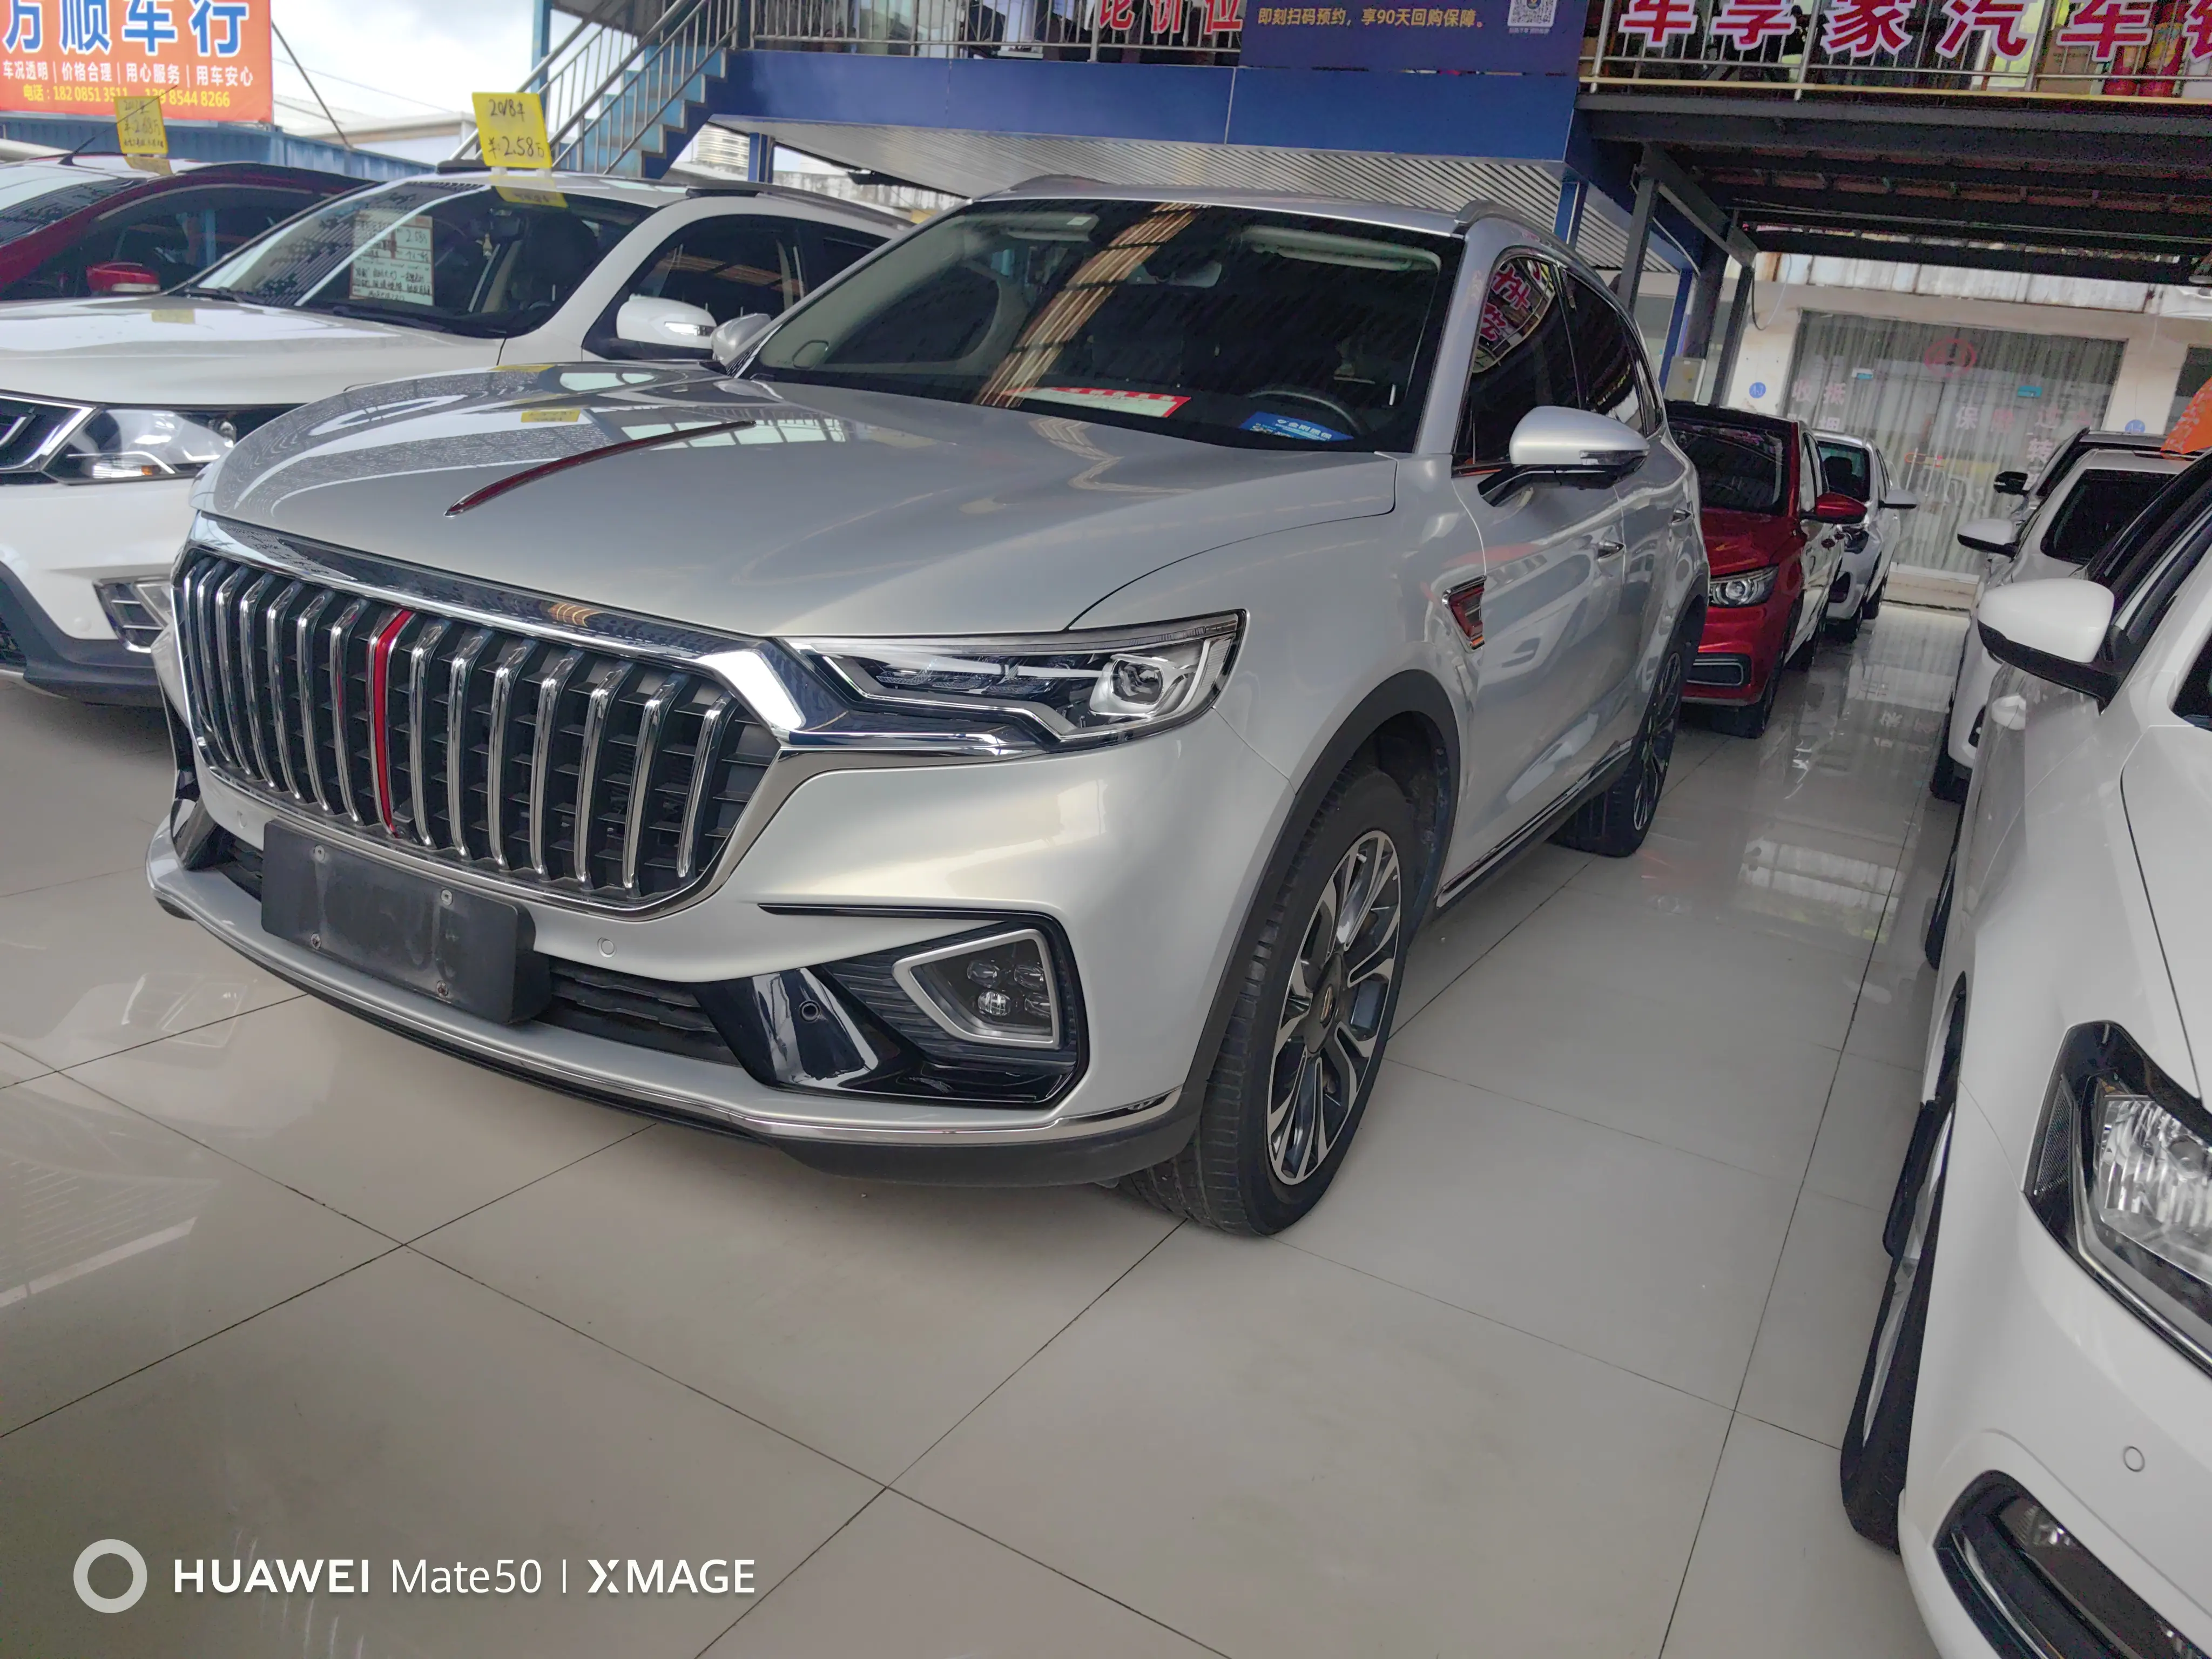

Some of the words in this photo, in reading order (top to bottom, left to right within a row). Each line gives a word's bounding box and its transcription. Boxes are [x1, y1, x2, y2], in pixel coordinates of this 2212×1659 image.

[1619, 0, 2212, 64] 车享家汽车
[3, 60, 49, 80] 车况透明
[61, 61, 112, 82] 价格合理
[126, 62, 180, 84] 用心服务
[196, 64, 253, 86] 用车安心
[75, 86, 102, 102] 0851
[169, 89, 198, 106] 8544
[200, 91, 230, 107] 8266
